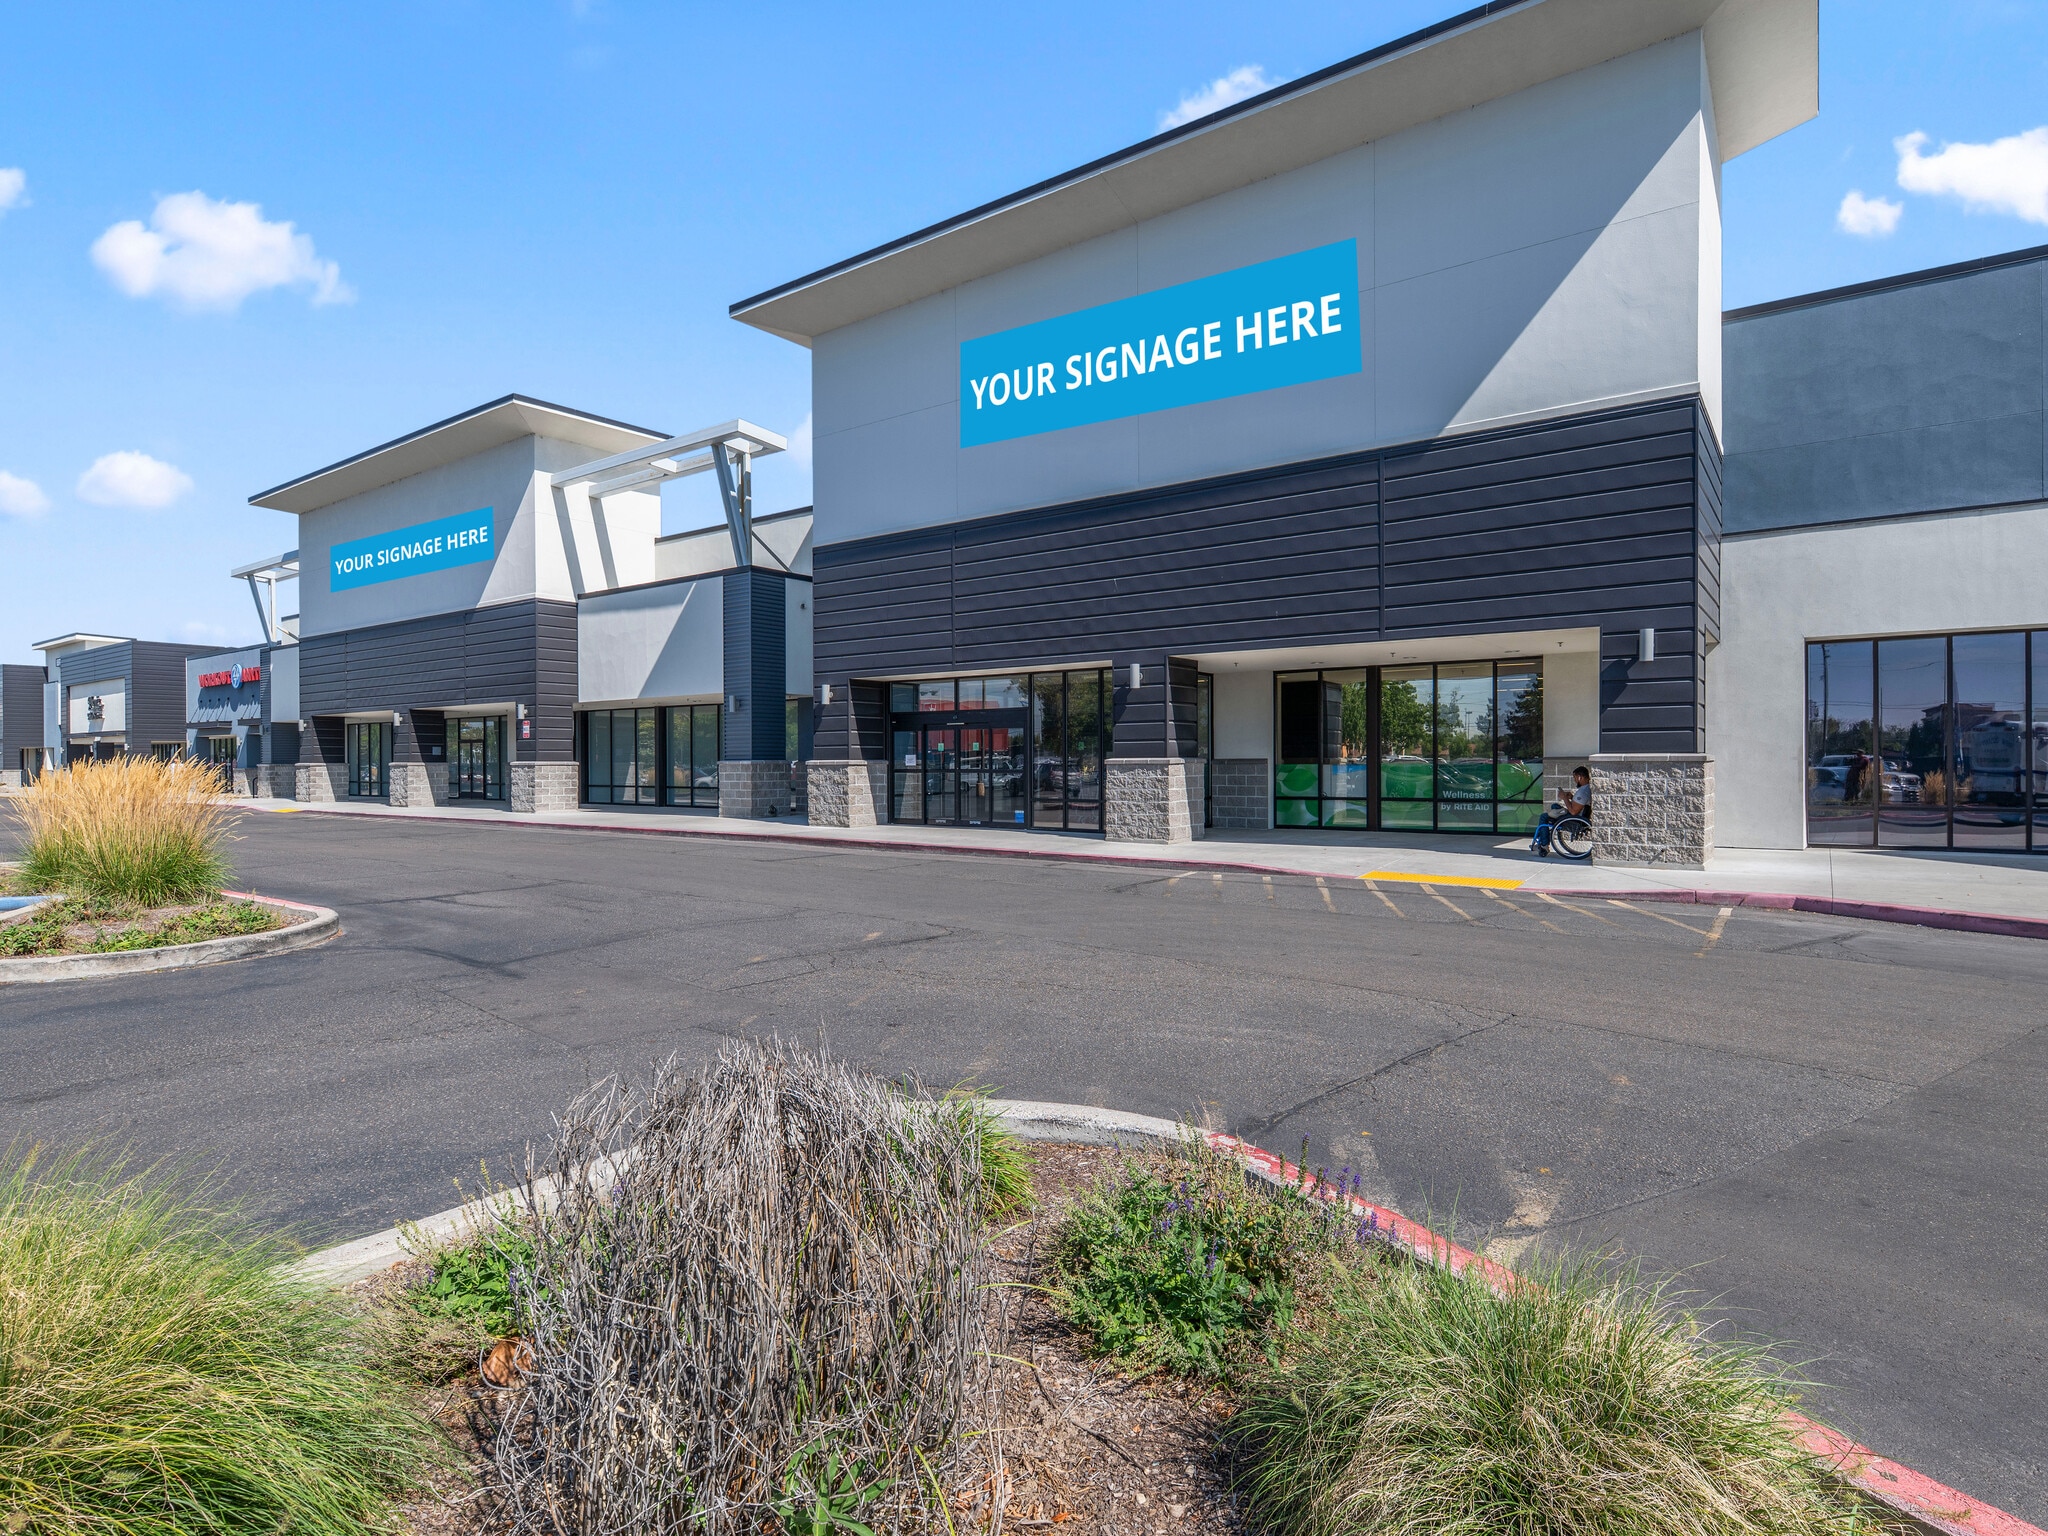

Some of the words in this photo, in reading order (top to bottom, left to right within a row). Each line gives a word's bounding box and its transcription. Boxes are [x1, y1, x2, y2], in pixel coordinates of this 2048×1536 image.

[969, 361, 1057, 410] YOUR
[1065, 320, 1222, 390] SIGNAGE
[1236, 292, 1342, 354] HERE
[335, 553, 374, 575] YOUR
[377, 536, 442, 566] SIGNAGE
[447, 526, 488, 550] HERE
[1441, 803, 1452, 811] by
[1454, 803, 1473, 811] RITE
[1442, 790, 1486, 799] Wellness
